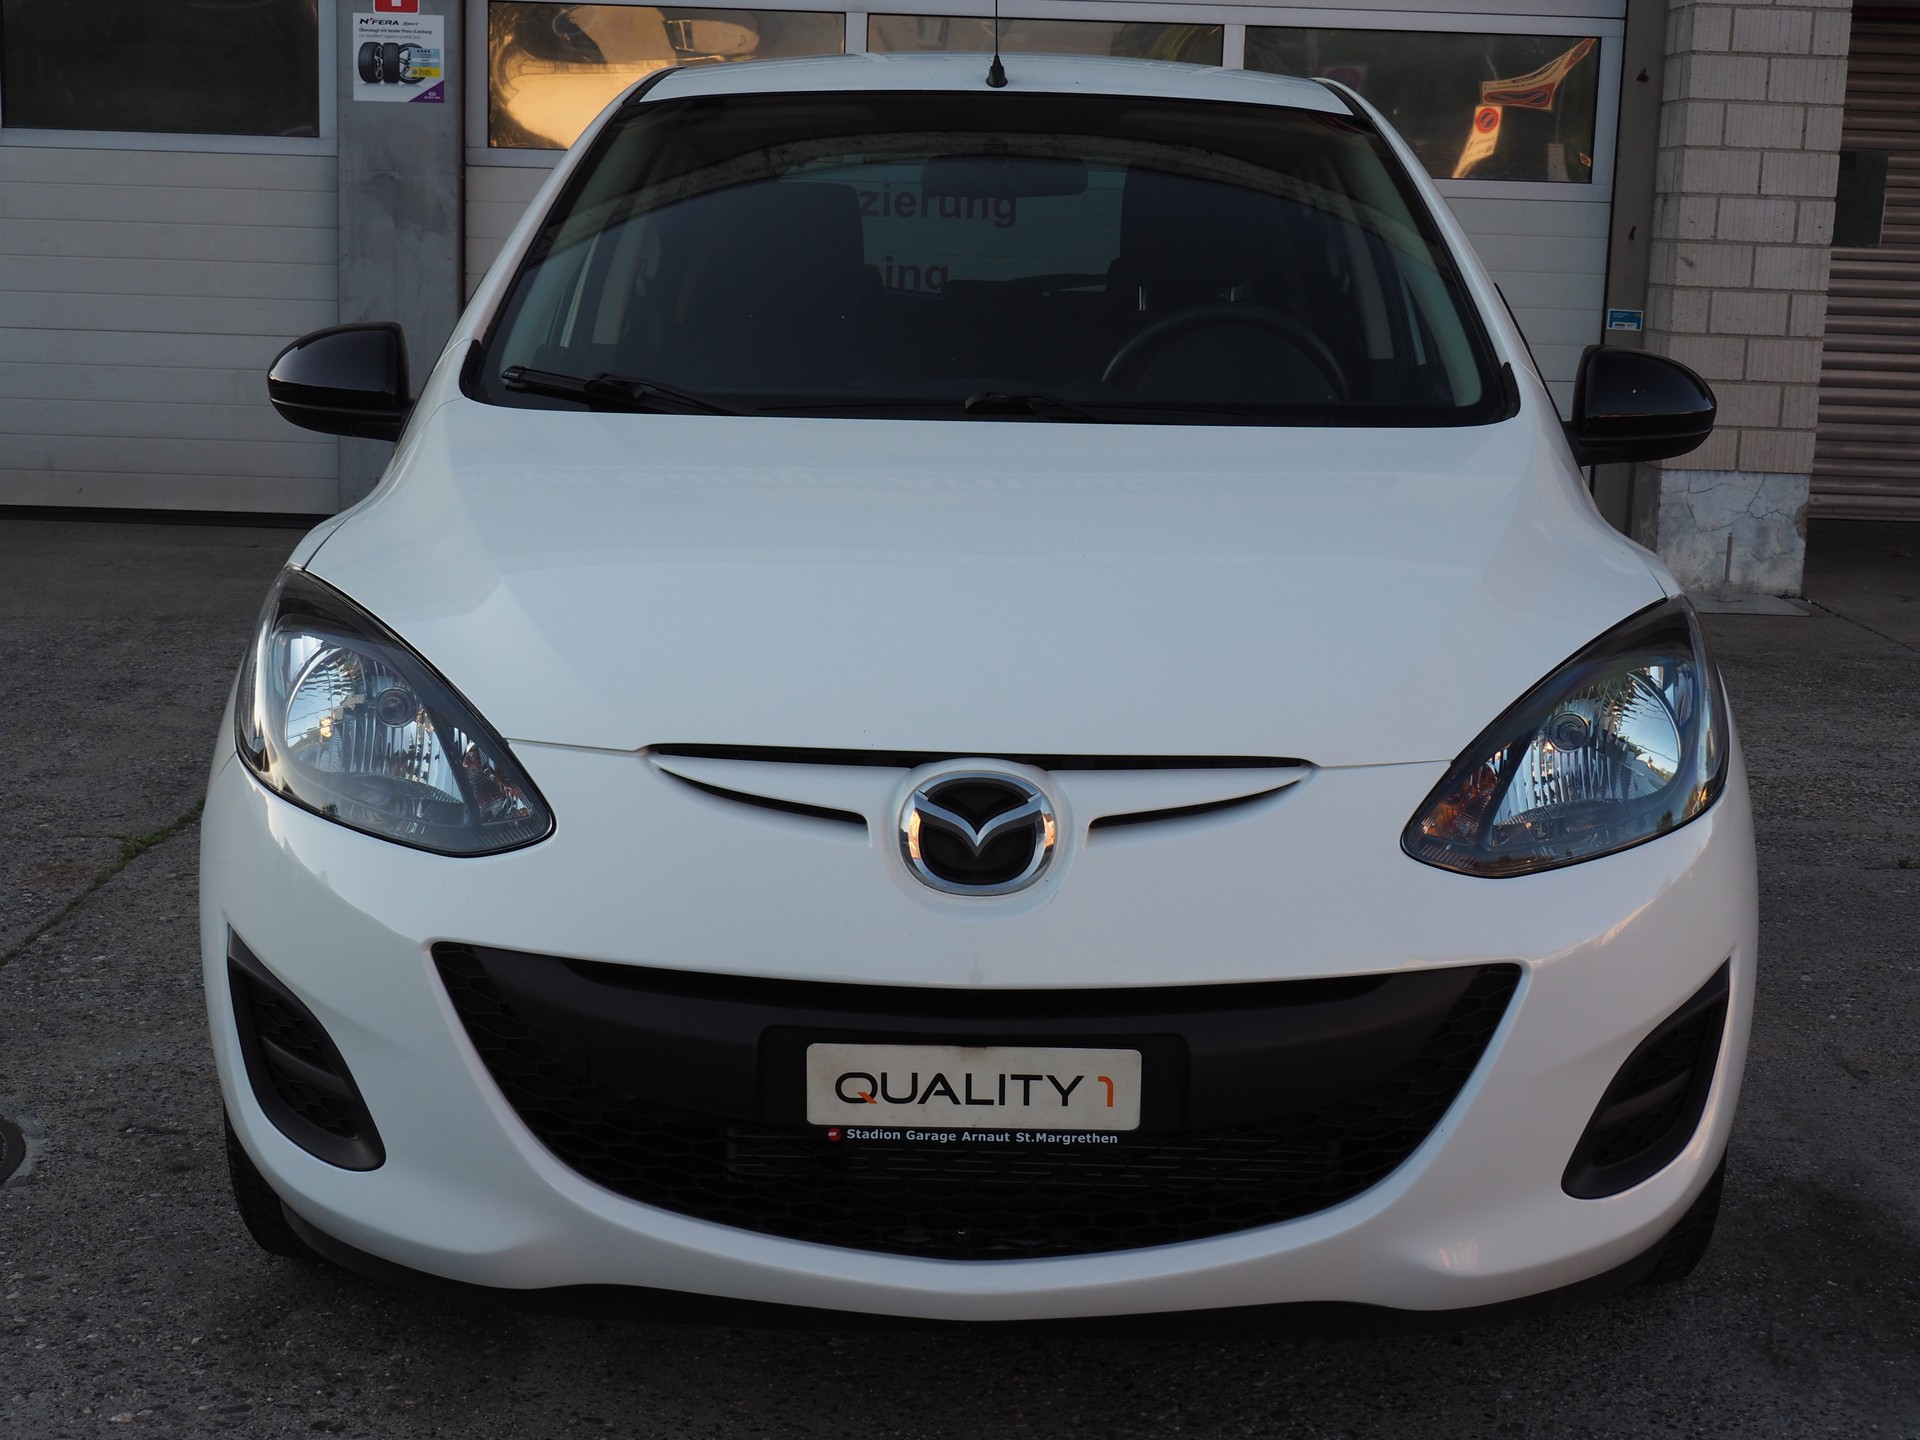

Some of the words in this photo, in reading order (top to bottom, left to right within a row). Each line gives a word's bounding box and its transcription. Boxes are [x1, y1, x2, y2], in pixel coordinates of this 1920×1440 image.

[864, 256, 949, 290] ing
[834, 1072, 1085, 1107] QUALITY
[1097, 1075, 1115, 1108] 1
[846, 1128, 901, 1141] Stadion
[905, 1130, 957, 1143] Garage
[961, 1131, 1010, 1143] Arnaut
[1015, 1132, 1119, 1146] St.Margrethen
